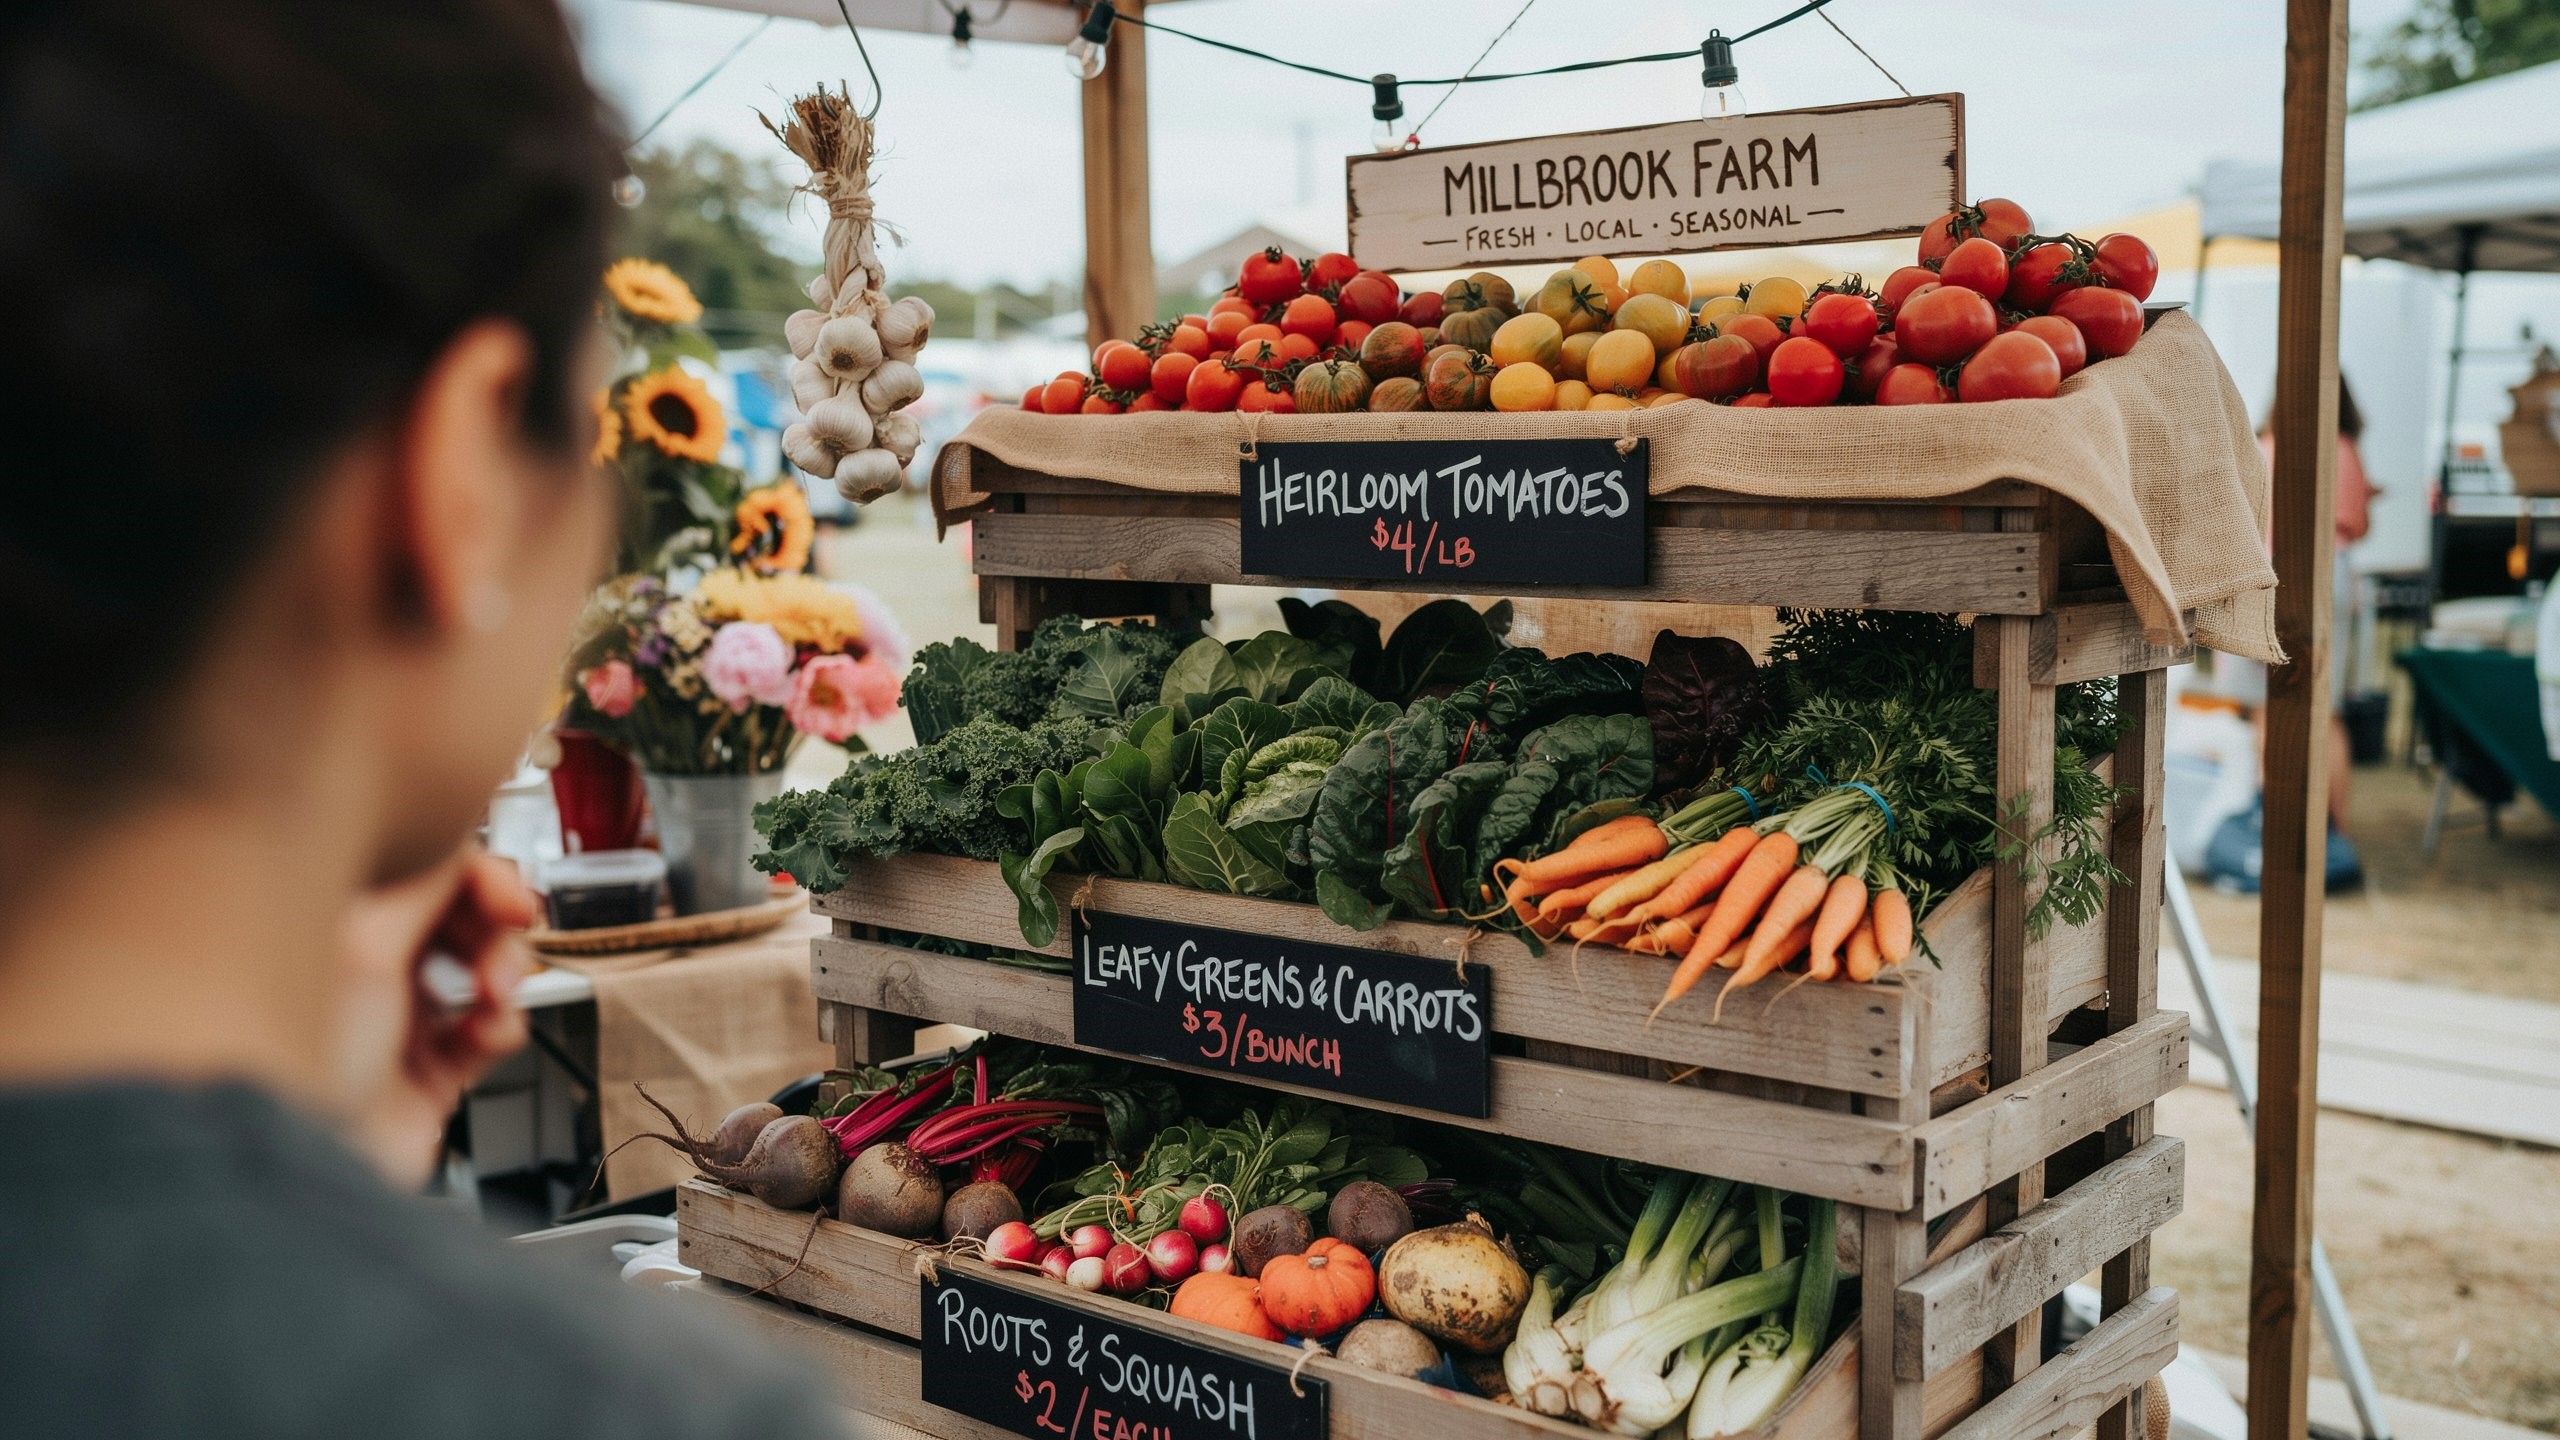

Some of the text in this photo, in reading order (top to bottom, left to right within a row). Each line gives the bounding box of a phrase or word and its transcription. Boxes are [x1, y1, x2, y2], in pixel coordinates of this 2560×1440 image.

[1444, 133, 1820, 216] MILLBROOK FARM
[1466, 205, 1801, 251] FRESH LOCAL SEASONAL
[1259, 455, 1630, 527] HEIRLOOM TOMATOES
[1370, 517, 1475, 574] $4/LB
[1084, 934, 1482, 1041] LEAFY GREENS & CARROTS
[1183, 1002, 1341, 1077] $3/BUNCH
[938, 1289, 1255, 1440] ROOTS & SQUASH
